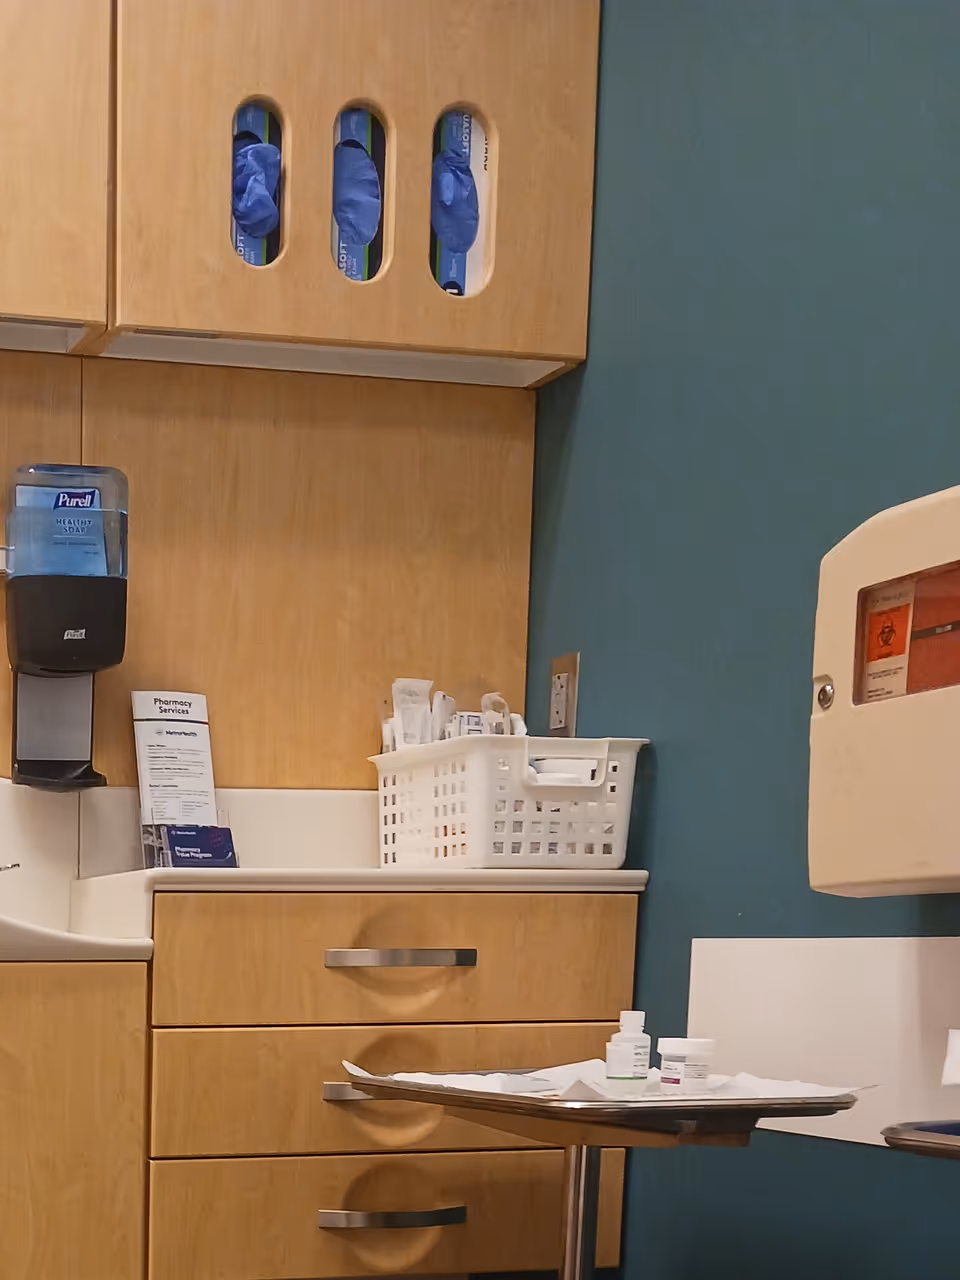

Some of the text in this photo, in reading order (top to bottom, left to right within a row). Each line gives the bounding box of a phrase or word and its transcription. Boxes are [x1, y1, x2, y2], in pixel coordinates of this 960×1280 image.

[339, 240, 347, 274] SOFT
[58, 492, 92, 507] Purell
[56, 518, 92, 526] HEALTHY
[64, 526, 88, 534] SOAP
[154, 698, 192, 708] Pharmacy
[158, 706, 190, 714] Services
